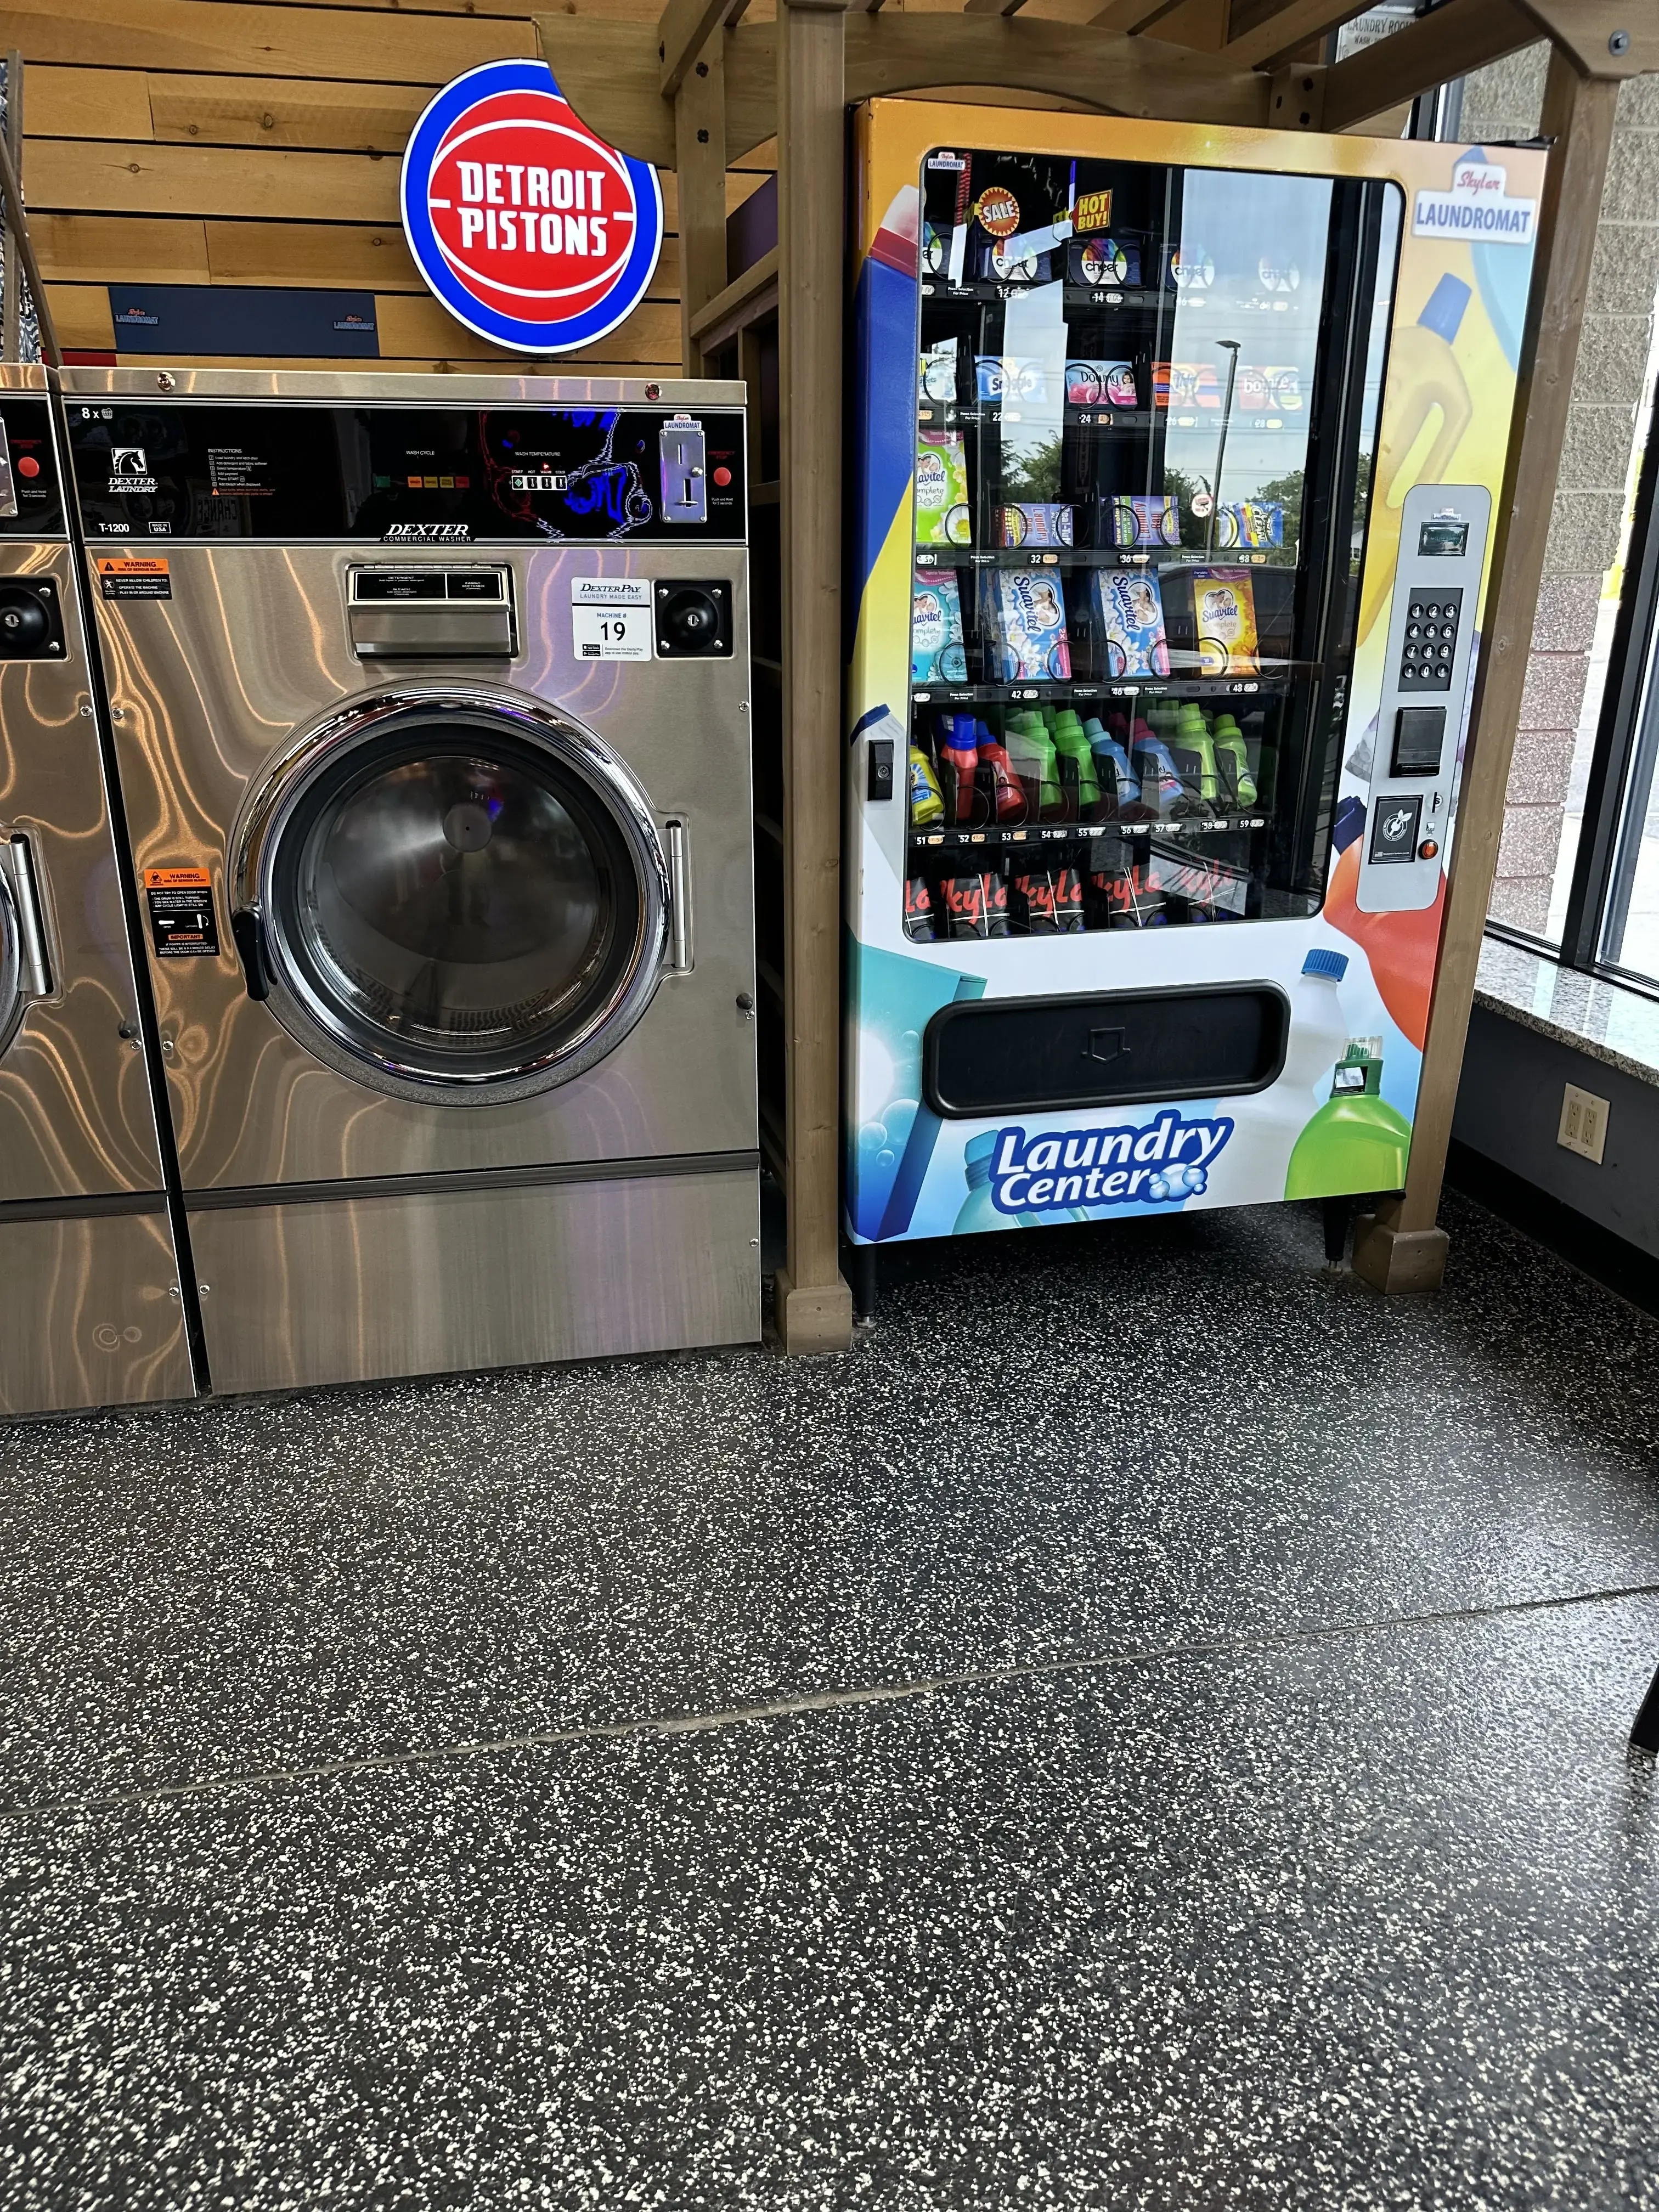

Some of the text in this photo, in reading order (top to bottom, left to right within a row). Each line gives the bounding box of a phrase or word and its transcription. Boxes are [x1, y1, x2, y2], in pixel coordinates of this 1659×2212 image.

[1347, 18, 1388, 33] LAUNDRY
[929, 160, 964, 168] LAUNDROMAT
[456, 161, 606, 211] DETROIT
[1457, 170, 1500, 196] Skylar
[1078, 193, 1108, 216] HOT
[983, 200, 1015, 223] SALE
[1077, 212, 1108, 230] BUY!
[1416, 202, 1531, 233] LAUNDROMAT
[456, 207, 608, 257] PISTONS
[1085, 262, 1118, 273] cheer
[998, 289, 1009, 298] 12
[1081, 371, 1119, 386] Downy
[82, 408, 91, 419] 8
[992, 412, 1002, 421] 22
[1080, 414, 1091, 423] 24
[665, 421, 701, 430] LAUNDROMAT
[99, 523, 129, 532] T-1200
[1251, 505, 1266, 541] CLEAN
[386, 524, 469, 535] DEXTER
[1030, 555, 1041, 563] 32
[1121, 554, 1131, 563] 36
[1014, 576, 1041, 632] Suavitel
[1113, 576, 1141, 630] Suavitel
[1202, 605, 1238, 623] Suavitel
[1448, 606, 1454, 614] 3
[600, 622, 626, 641] 19
[1430, 627, 1435, 635] 5
[1446, 627, 1451, 635] 6
[1410, 646, 1448, 655] 7 8 9
[1424, 667, 1429, 675] 0
[1113, 687, 1122, 696] 46
[1233, 684, 1243, 692] 48
[1011, 691, 1022, 699] 42
[1122, 826, 1131, 834] 56
[1155, 824, 1164, 832] 57
[997, 1116, 1227, 1175] Laundry
[1000, 1167, 1151, 1206] Center
